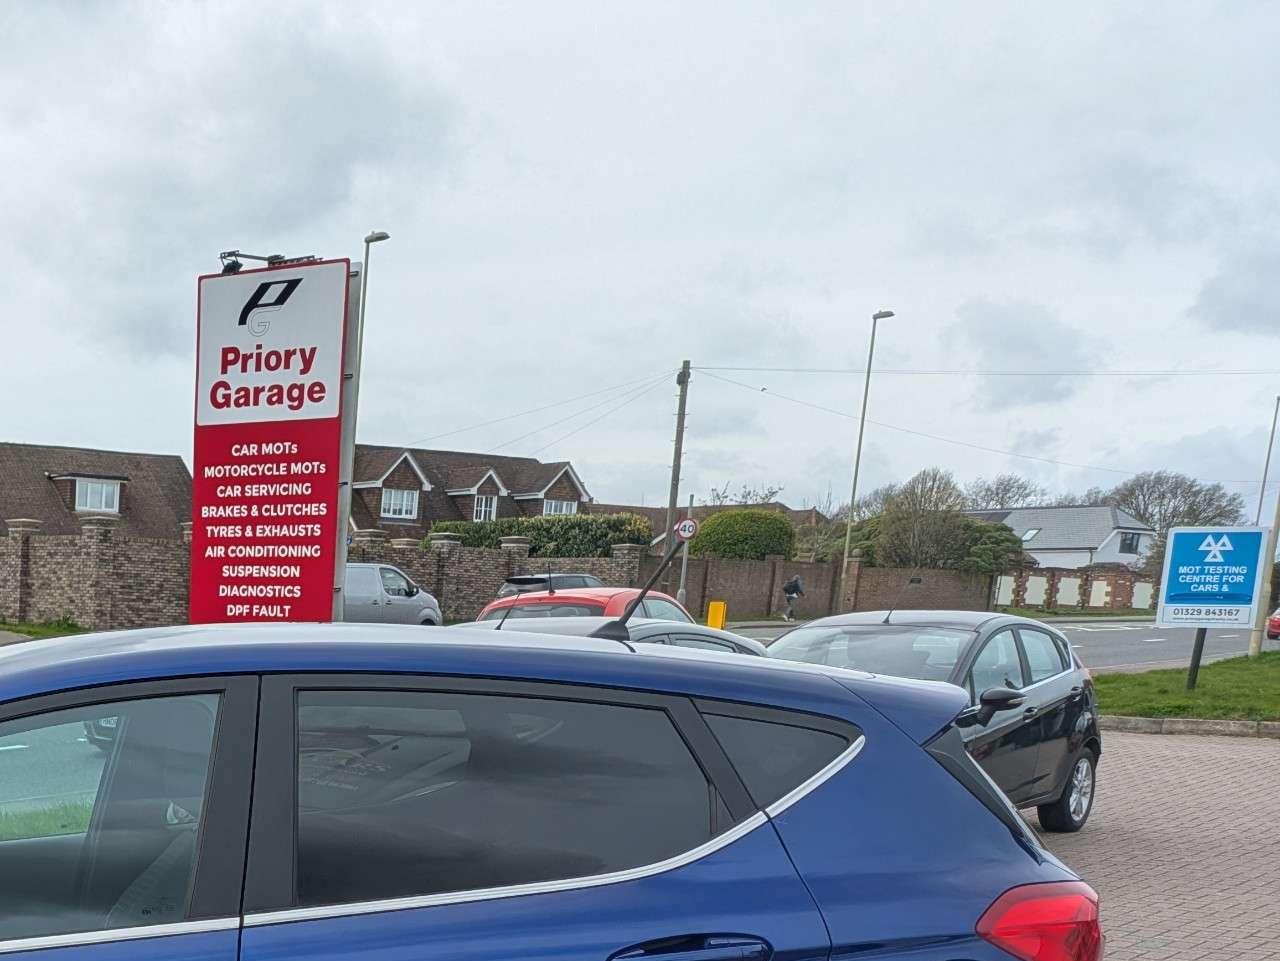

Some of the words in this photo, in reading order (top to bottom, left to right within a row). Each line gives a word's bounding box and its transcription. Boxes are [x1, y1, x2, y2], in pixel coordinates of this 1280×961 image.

[220, 344, 317, 376] Priory
[210, 380, 326, 411] Garage
[231, 444, 258, 457] CAR
[261, 442, 298, 455] MOTs
[204, 464, 287, 478] MOTORCYCLE
[290, 461, 326, 475] MOTs
[216, 485, 242, 498] CAR
[245, 482, 312, 497] SERVICING
[201, 504, 248, 518] BRAKES
[251, 504, 259, 517] &
[262, 502, 328, 516] CLUTCHES
[206, 525, 242, 538] TYRES
[244, 525, 253, 538] &
[256, 524, 321, 537] EXHAUSTS
[680, 524, 694, 533] 40
[205, 546, 225, 558] AIR
[227, 545, 321, 558] CONDITIONING
[222, 565, 301, 578] SUSPENSION
[1179, 566, 1201, 574] MOT
[1204, 566, 1247, 574] TESTING
[1178, 575, 1220, 583] CENTRE
[1222, 575, 1245, 583] FOR
[219, 585, 302, 598] DIAGNOSTICS
[1190, 584, 1219, 592] CARS
[1221, 584, 1229, 592] &
[227, 605, 250, 617] DPF
[253, 605, 291, 617] FAULT
[1173, 607, 1202, 616] 01329
